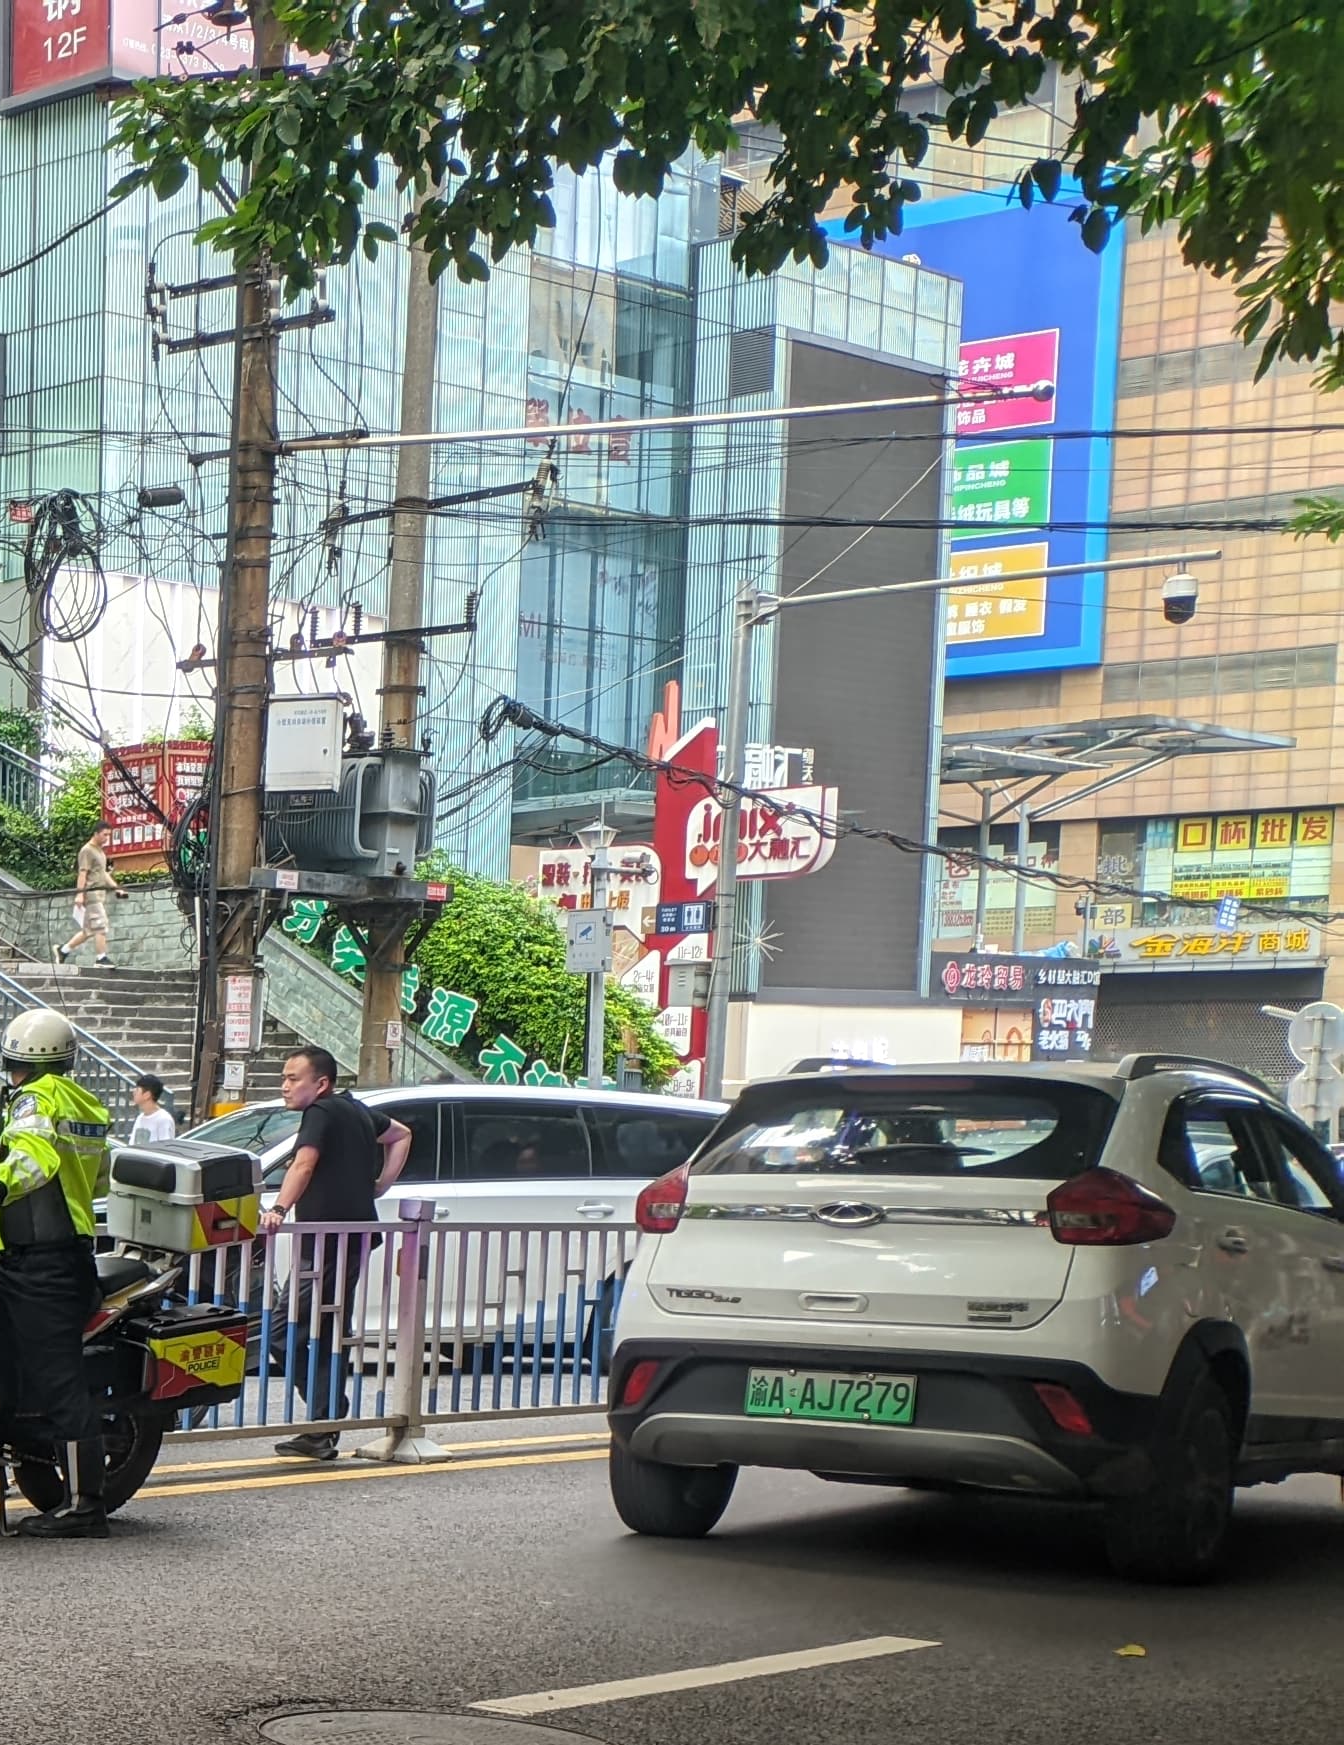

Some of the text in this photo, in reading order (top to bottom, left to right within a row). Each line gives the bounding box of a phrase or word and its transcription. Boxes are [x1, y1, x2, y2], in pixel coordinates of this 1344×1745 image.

[43, 25, 87, 62] 12F
[1182, 816, 1329, 847] 口杯批发
[748, 836, 811, 861] 大融汇
[1130, 927, 1311, 958] 金海洋商城
[633, 969, 655, 983] 2F-4F
[188, 1360, 218, 1372] POLICE
